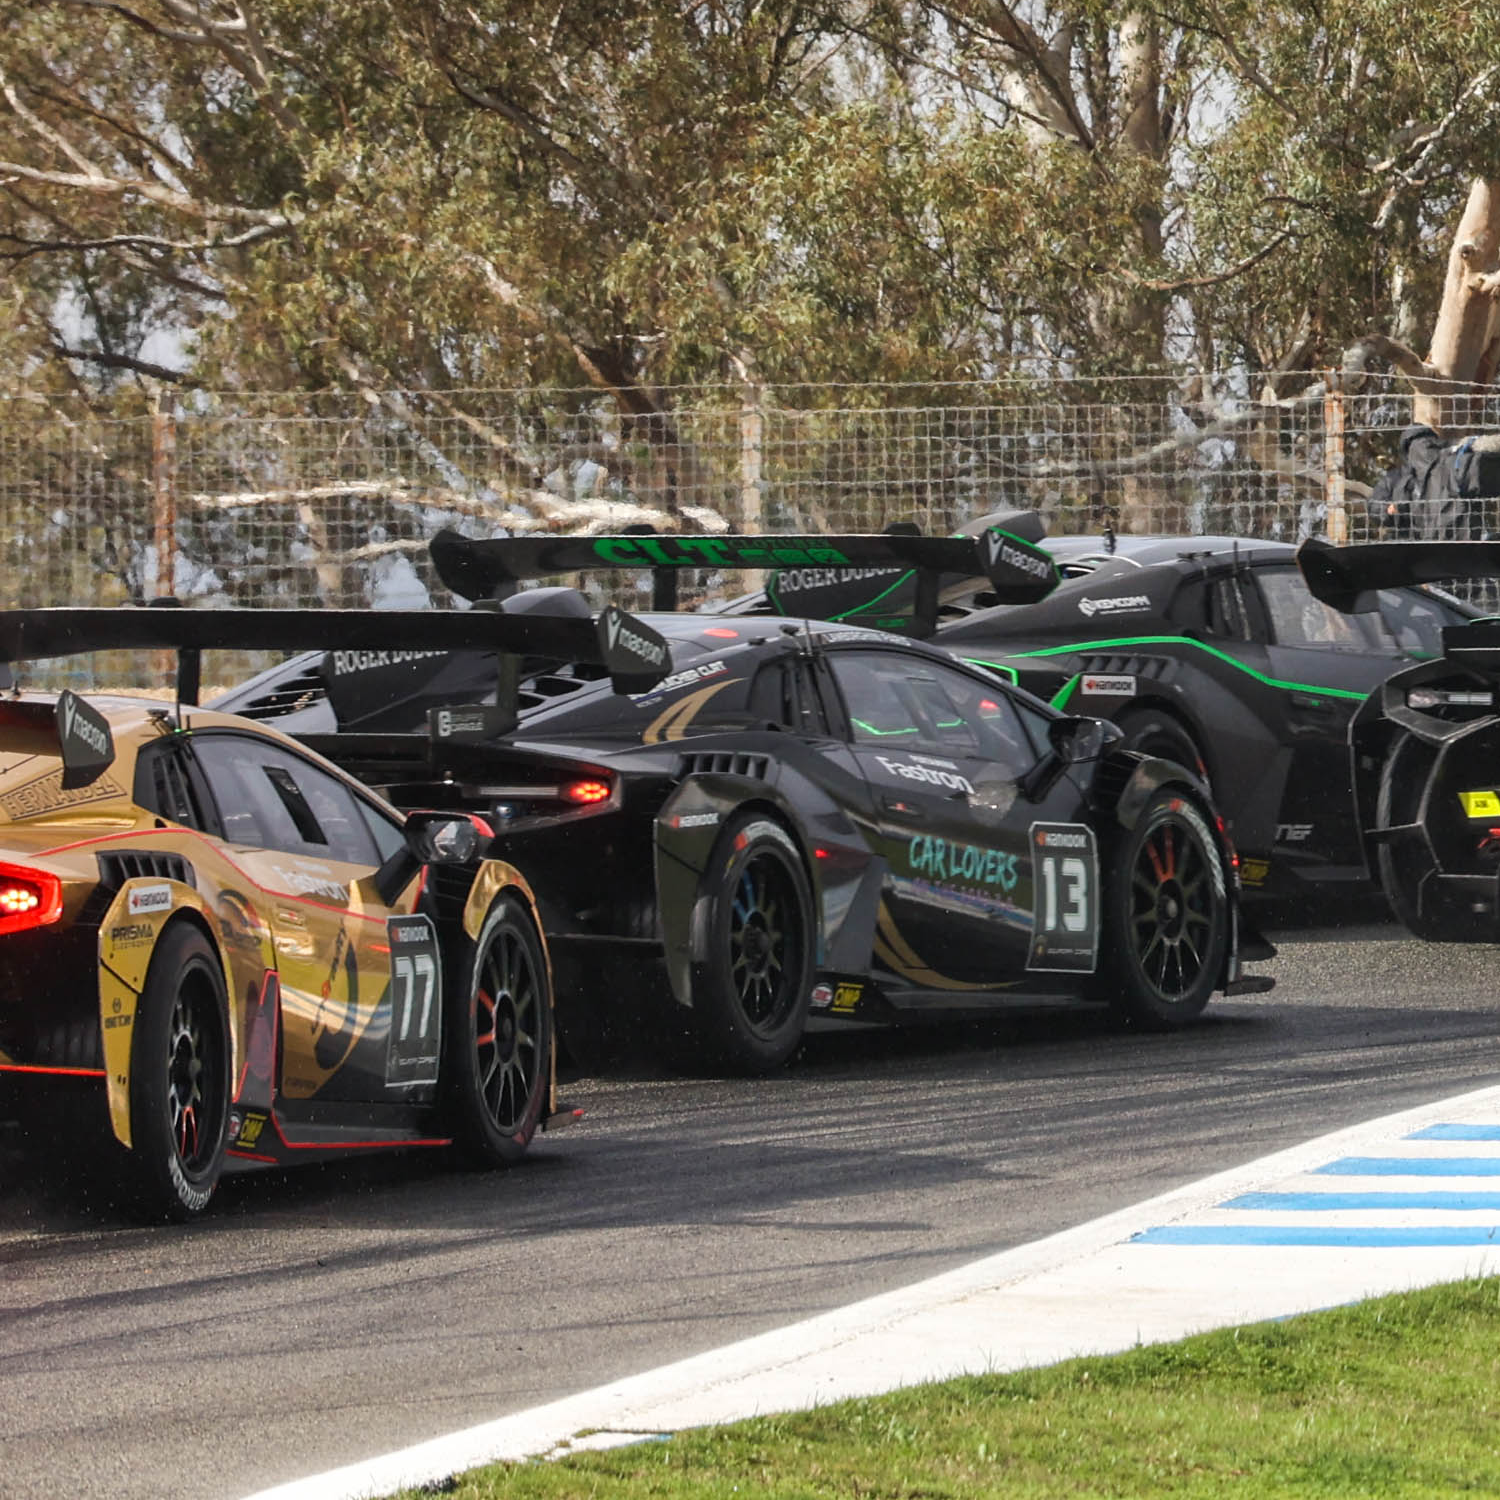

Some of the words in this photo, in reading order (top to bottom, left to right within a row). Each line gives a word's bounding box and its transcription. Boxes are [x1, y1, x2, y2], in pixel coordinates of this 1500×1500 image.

[594, 538, 734, 565] CLT
[1001, 546, 1049, 580] macron
[779, 569, 836, 593] ROGER
[334, 650, 390, 676] ROGER
[874, 755, 976, 795] Fastron
[909, 835, 947, 880] CAR
[950, 841, 1019, 892] LOVERS
[1042, 857, 1088, 932] 13
[395, 954, 435, 1041] 77
